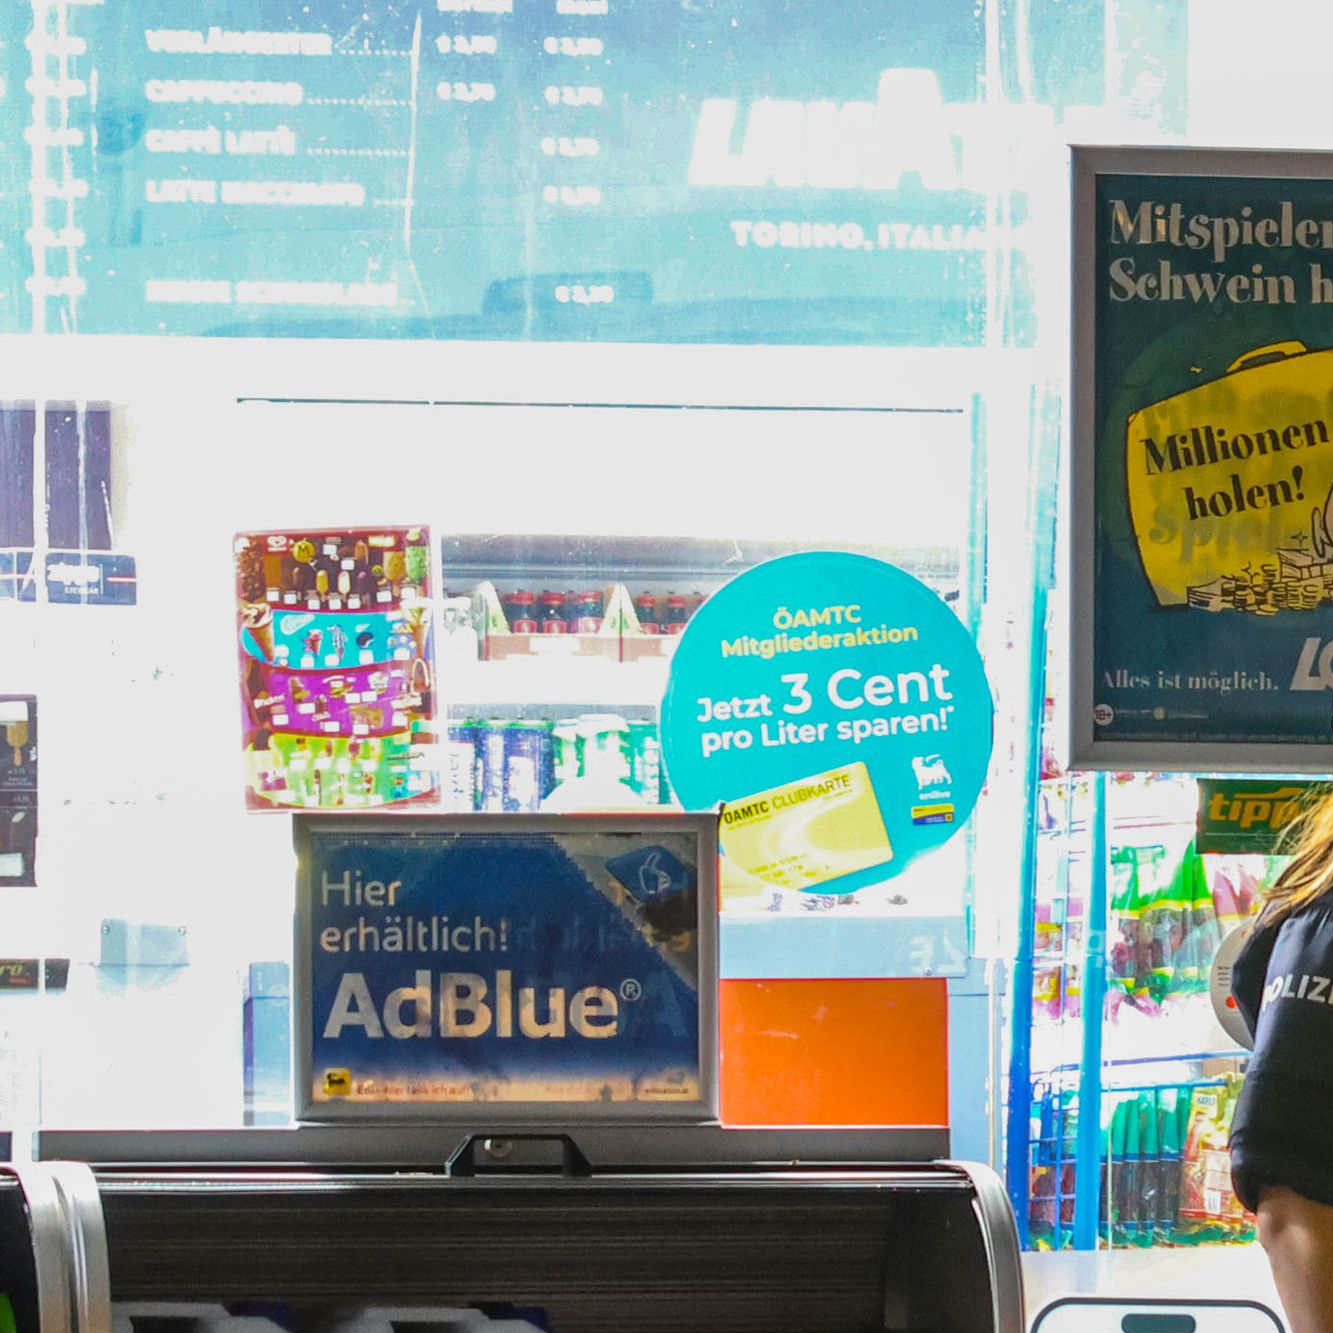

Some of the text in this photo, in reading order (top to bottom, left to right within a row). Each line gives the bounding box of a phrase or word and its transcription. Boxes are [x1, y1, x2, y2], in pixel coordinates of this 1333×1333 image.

[1108, 258, 1297, 303] Schwein
[1140, 418, 1330, 476] Millionen
[1184, 465, 1305, 520] holen!
[772, 604, 862, 629] ÖAMTC
[721, 625, 918, 659] Mitgliederaktion
[697, 664, 954, 723] Jetzt 3 Cent
[1104, 670, 1279, 693] Alles ist möglich.
[701, 729, 753, 758] pro
[761, 720, 829, 748] Liter
[320, 870, 401, 906] Hier
[319, 915, 509, 953] erhältlich!
